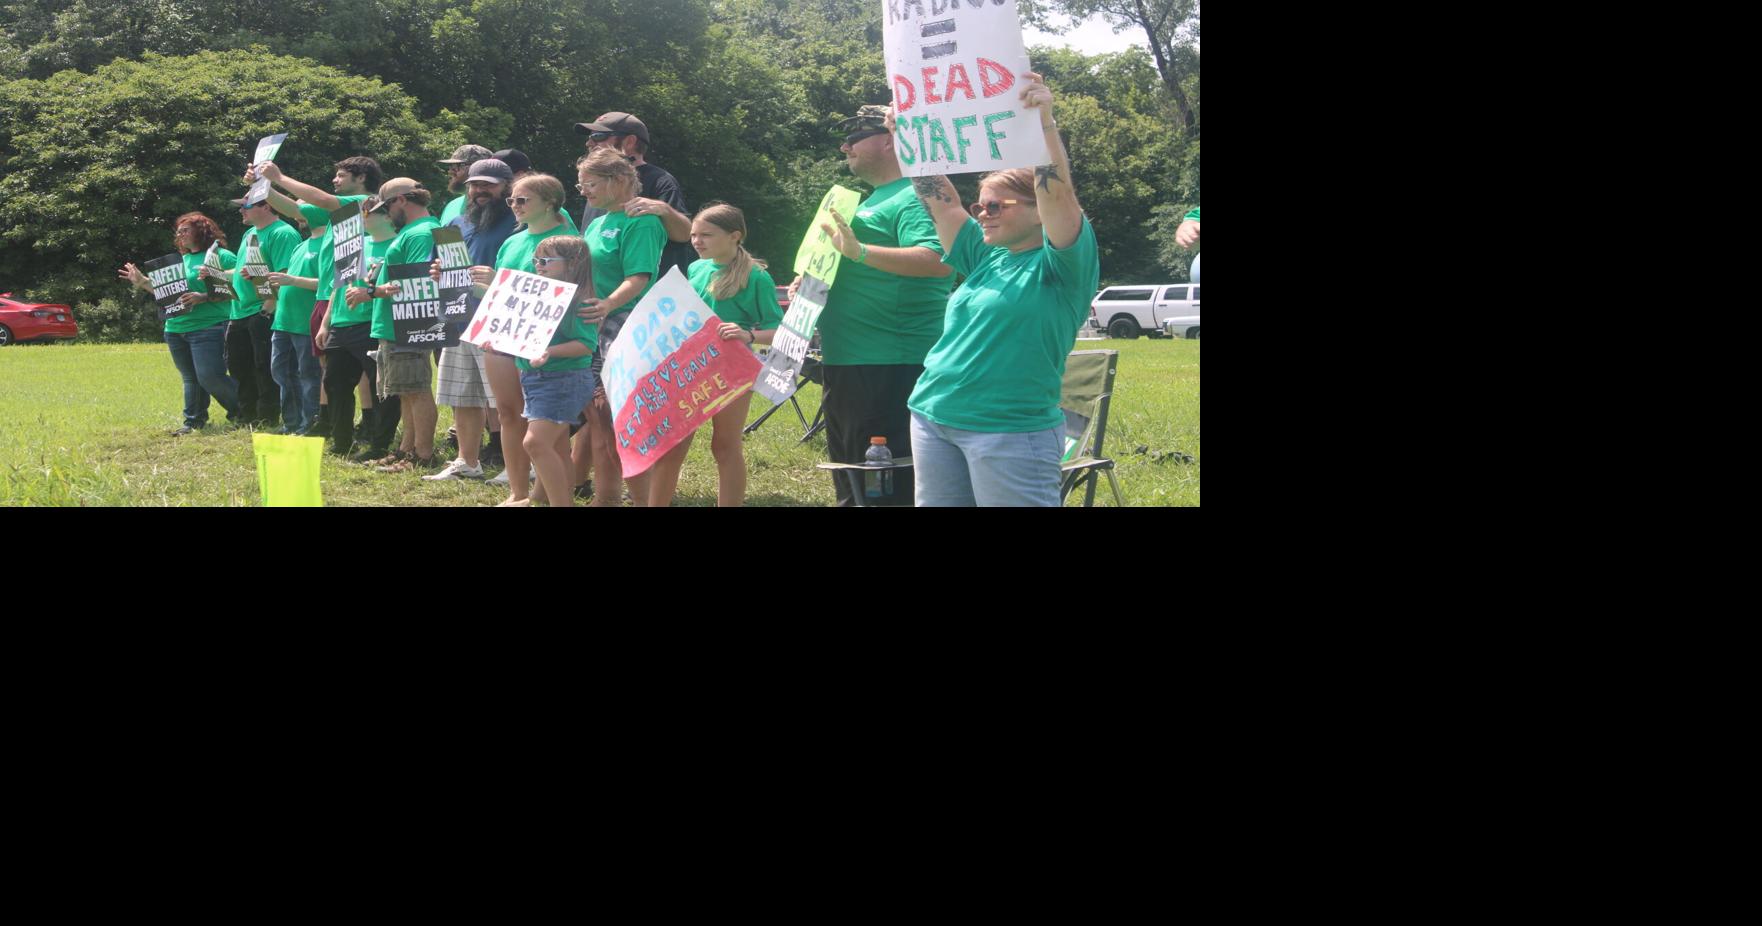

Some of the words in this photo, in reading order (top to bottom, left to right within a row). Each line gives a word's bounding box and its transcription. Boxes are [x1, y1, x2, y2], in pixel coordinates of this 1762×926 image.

[893, 57, 1016, 113] DEAD
[895, 110, 1016, 165] STAFF
[333, 213, 361, 246] SAFETY
[334, 235, 362, 262] MATTERS!
[437, 241, 472, 269] SAFETY
[148, 262, 185, 288] SAFETY
[511, 274, 549, 296] KEEP
[153, 279, 189, 300] MATTERS!
[391, 277, 440, 302] SAFET
[392, 301, 440, 320] MATTER
[445, 304, 467, 315] AFSCME
[504, 294, 530, 317] MY
[533, 300, 564, 321] DAD
[782, 294, 824, 337] SAFETY
[632, 296, 676, 350] DAD
[408, 332, 446, 343] AFSCME
[641, 310, 703, 371] IRAQ
[619, 411, 642, 448] LET
[676, 343, 720, 389] LEAVE
[633, 357, 679, 409] ALIVE
[678, 372, 727, 418] SAFE
[765, 373, 790, 394] AFSCME
